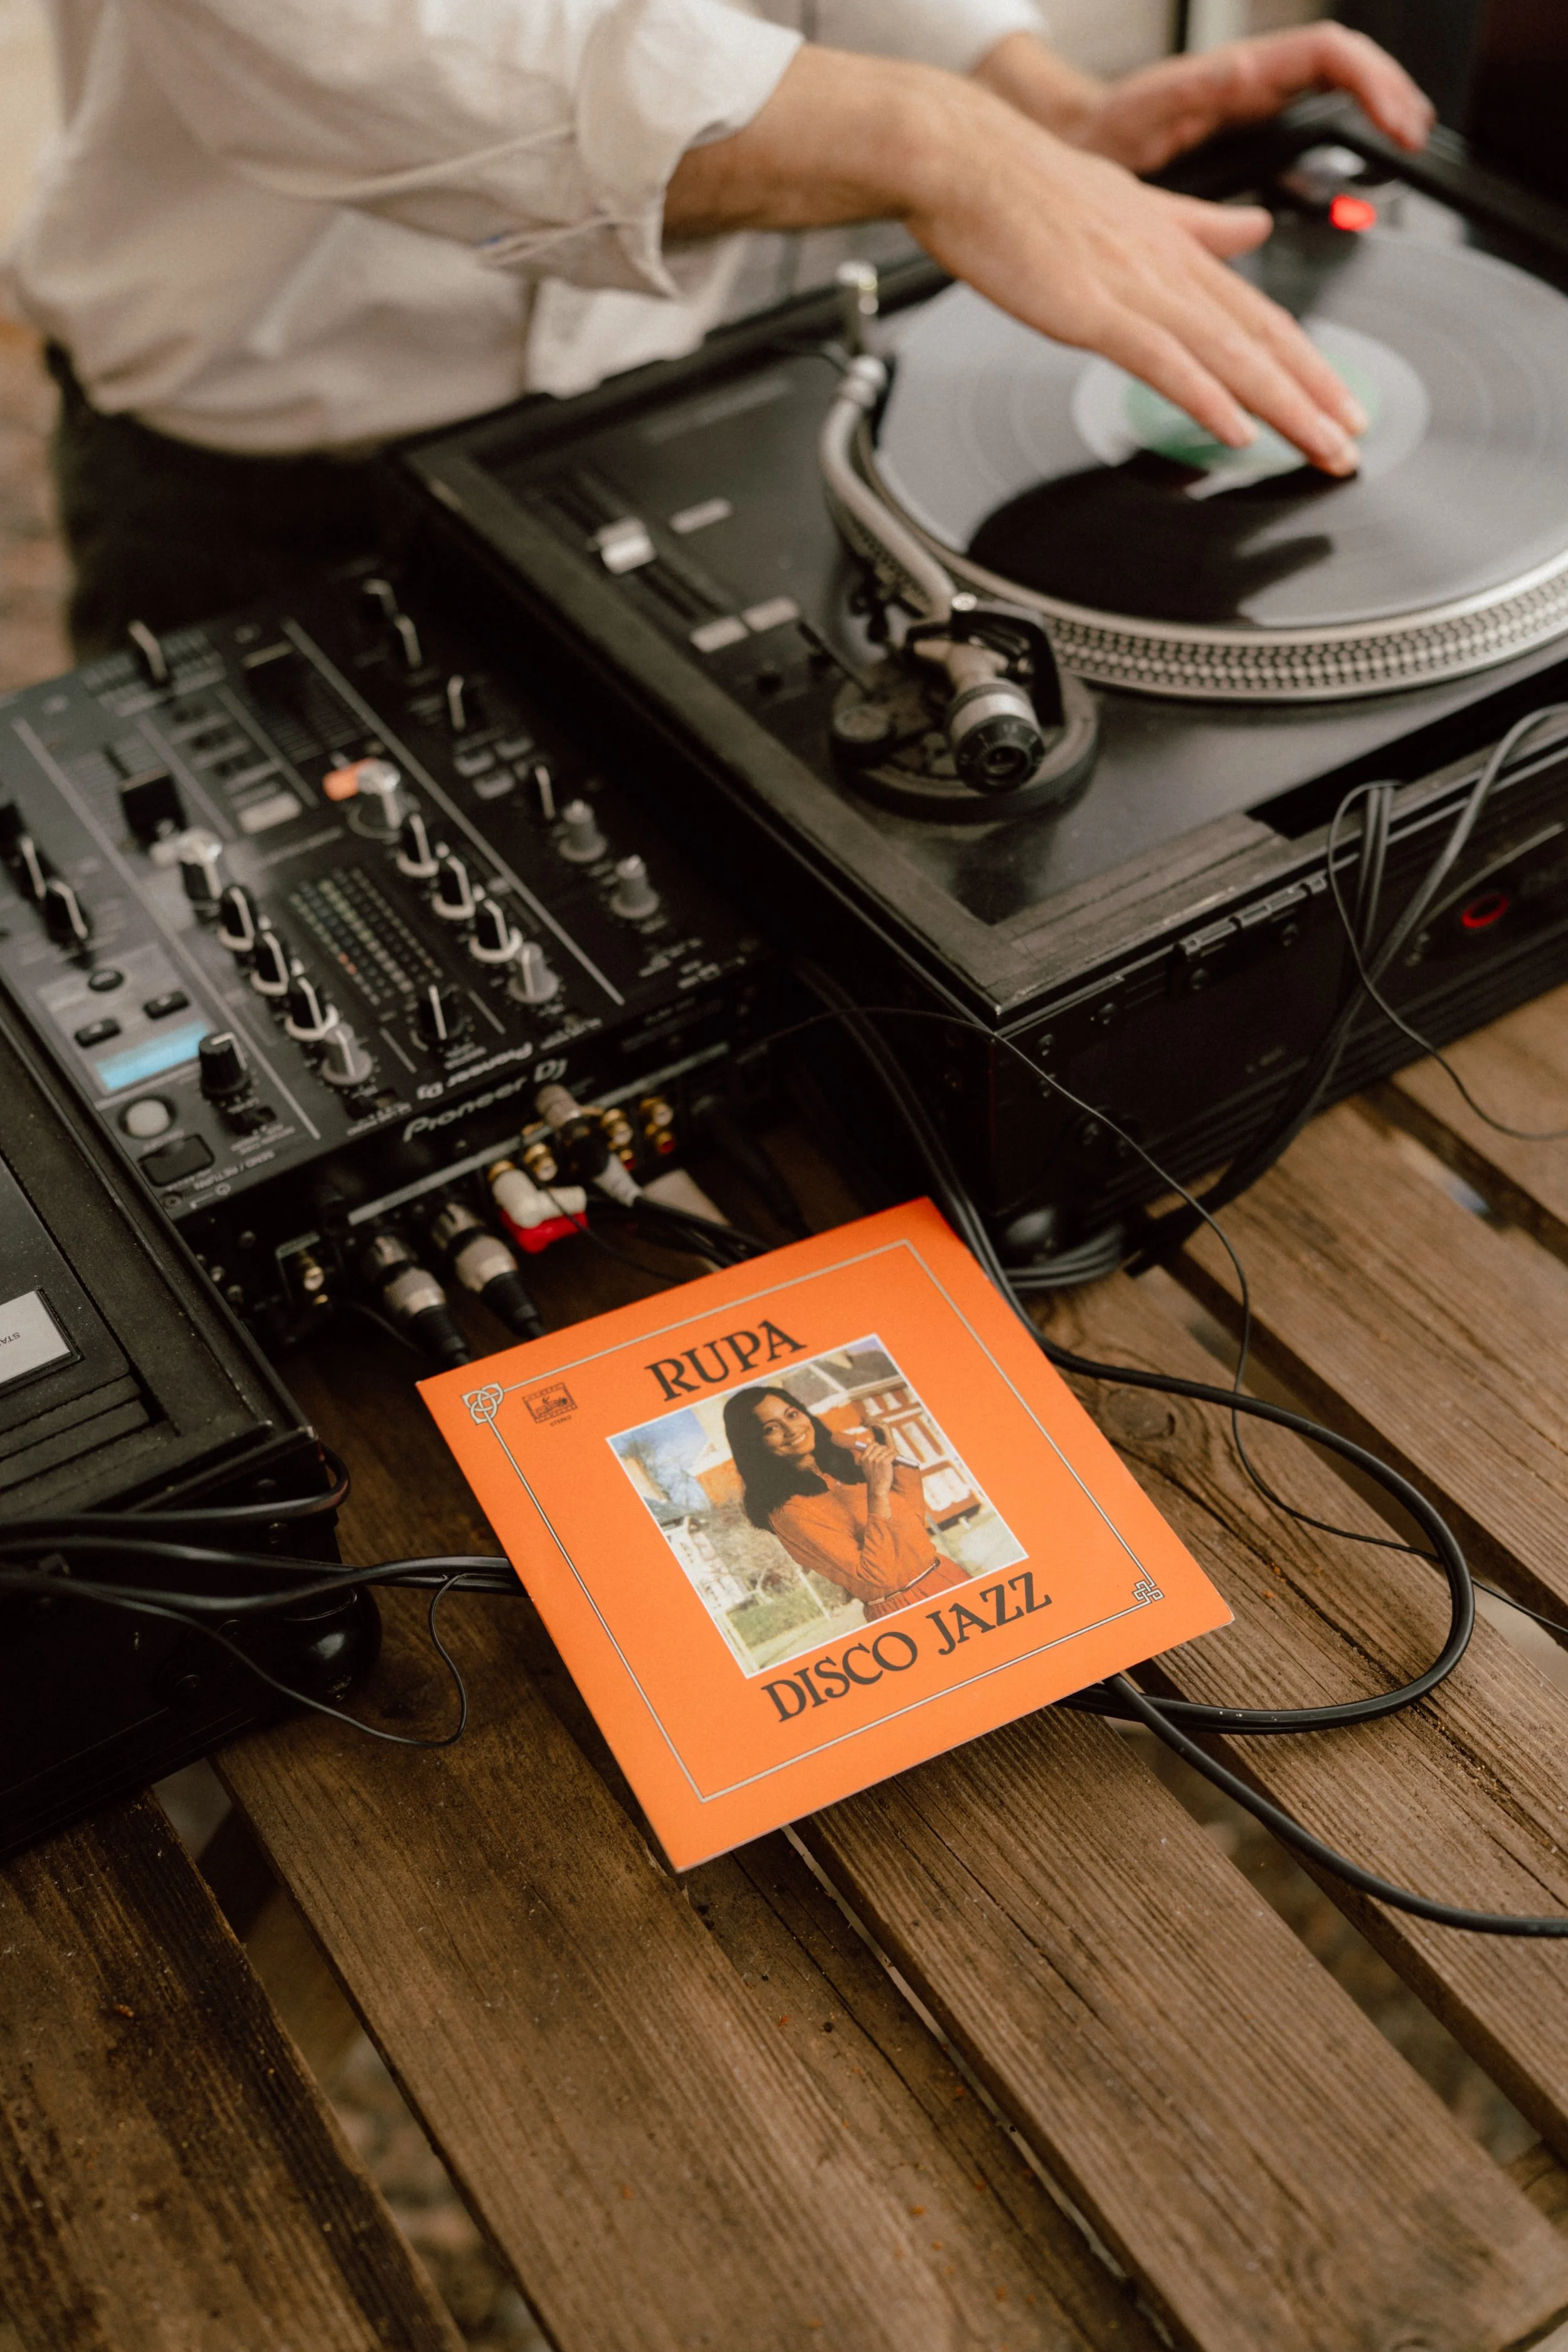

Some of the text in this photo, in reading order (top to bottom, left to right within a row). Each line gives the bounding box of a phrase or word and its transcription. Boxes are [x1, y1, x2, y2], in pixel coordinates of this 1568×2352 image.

[534, 1057, 568, 1083] DJ
[644, 1320, 808, 1402] RUPA
[761, 1571, 1052, 1723] DISCO JAZZ
